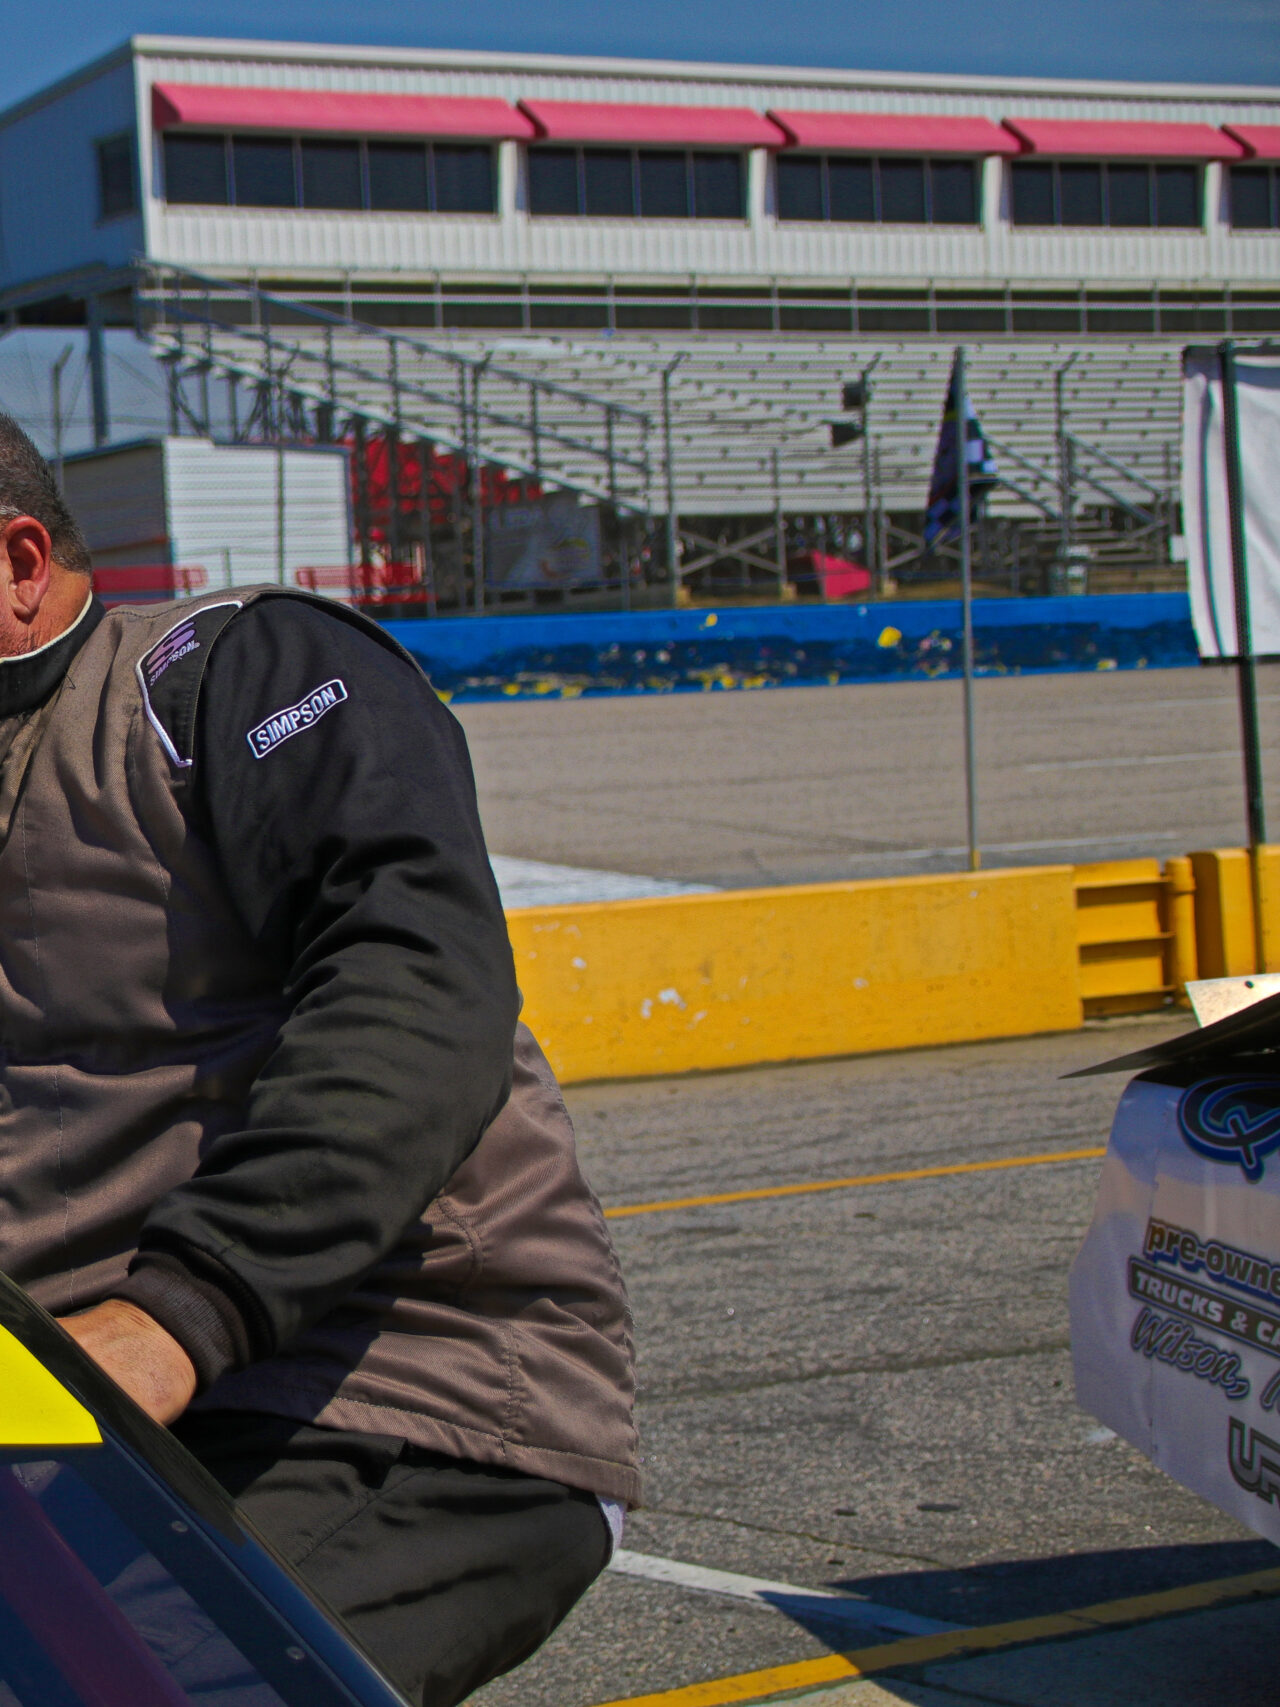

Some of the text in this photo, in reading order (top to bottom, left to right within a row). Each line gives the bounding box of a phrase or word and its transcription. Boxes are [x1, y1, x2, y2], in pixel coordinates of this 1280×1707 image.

[150, 640, 195, 686] SIMPSON
[255, 685, 337, 751] SIMPSON
[1135, 1269, 1225, 1323] TRUCKS
[1230, 1310, 1249, 1334] &
